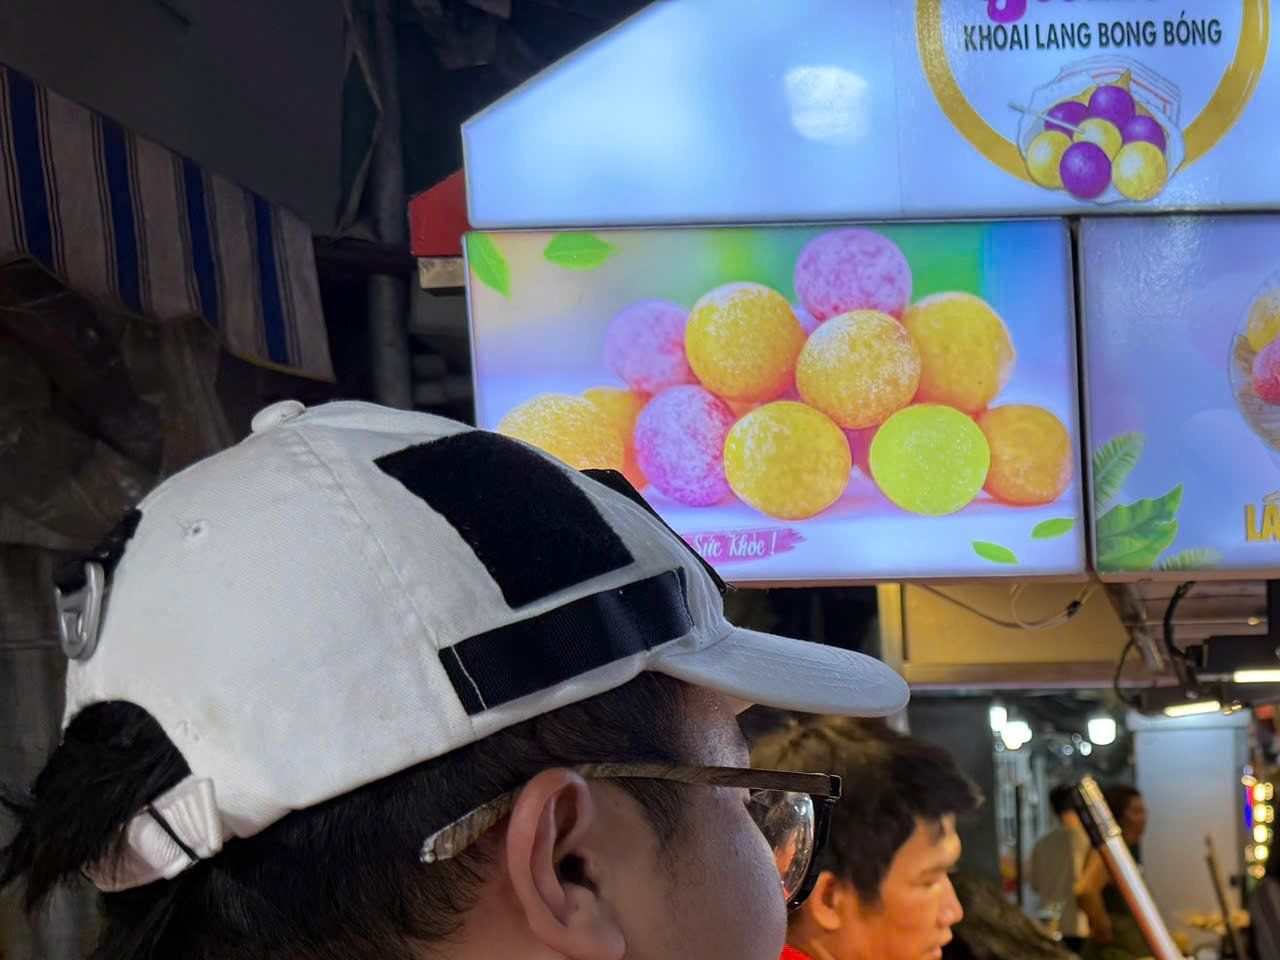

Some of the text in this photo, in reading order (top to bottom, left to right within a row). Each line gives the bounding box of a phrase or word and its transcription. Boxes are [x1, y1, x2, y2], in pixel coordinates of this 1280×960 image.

[963, 10, 1223, 52] KHOAI LANG BONG BÓNG
